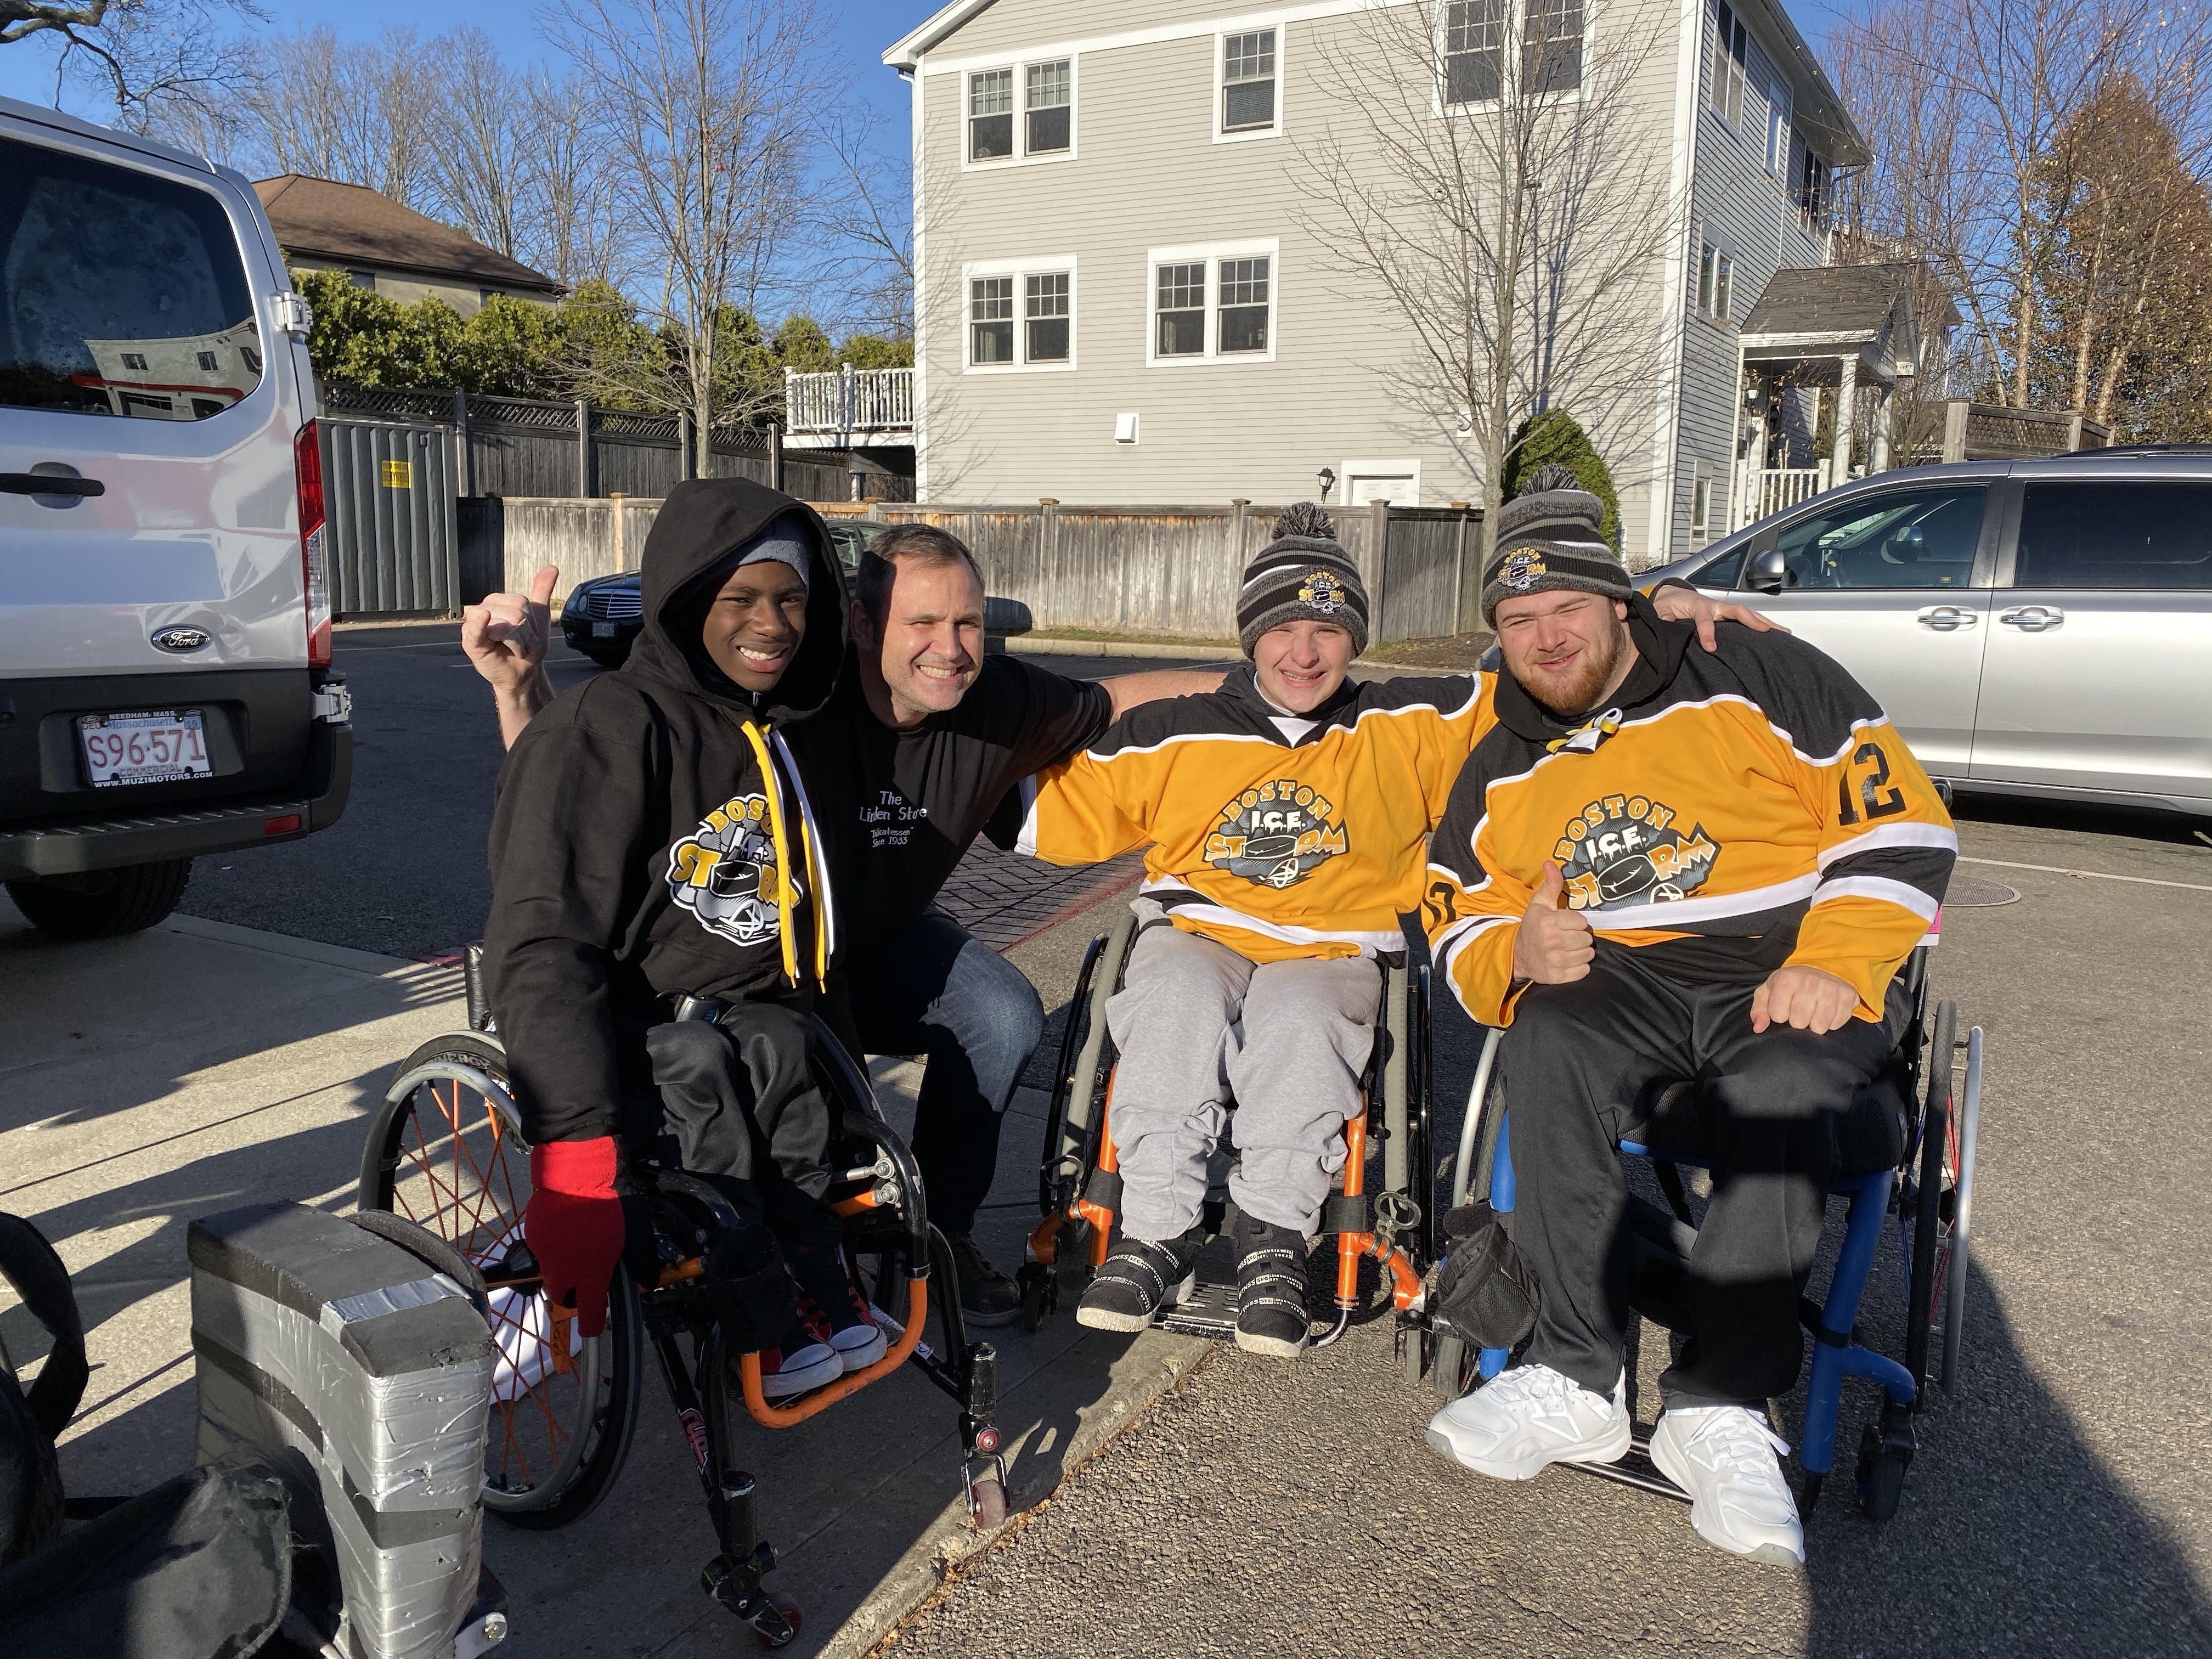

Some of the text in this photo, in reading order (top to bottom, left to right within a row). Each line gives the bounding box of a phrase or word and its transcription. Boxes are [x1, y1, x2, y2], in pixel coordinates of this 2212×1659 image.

[168, 631, 199, 647] Ford
[93, 771, 213, 788] WWW.MUZIMOTORS.COM
[119, 764, 182, 777] COMMERCIAL
[1838, 742, 1907, 826] 12
[879, 791, 902, 805] The
[1223, 781, 1332, 822] BOSTON
[898, 806, 927, 820] Stoe
[1251, 811, 1306, 834] I.C.E.
[1554, 795, 1674, 862] BOSTON
[888, 837, 907, 845] 1933
[1204, 825, 1346, 862] STORM
[1585, 825, 1647, 866] I.C.E.
